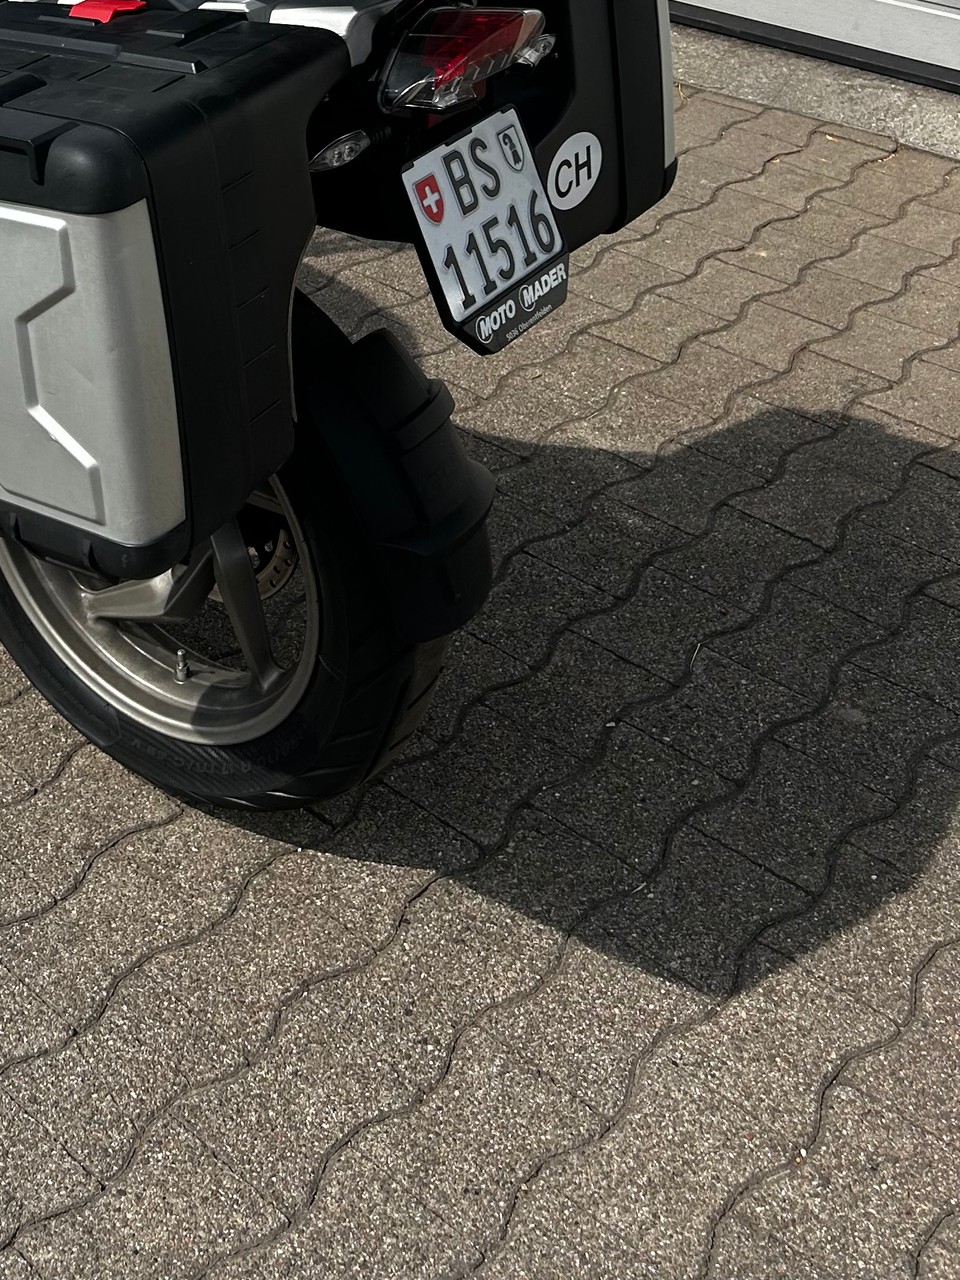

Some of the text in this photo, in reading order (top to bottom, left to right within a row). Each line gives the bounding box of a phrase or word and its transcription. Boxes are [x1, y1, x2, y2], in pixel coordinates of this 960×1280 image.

[441, 137, 501, 217] BS
[554, 145, 592, 199] CH
[444, 190, 555, 310] 11516
[478, 263, 567, 338] MOTO MADER
